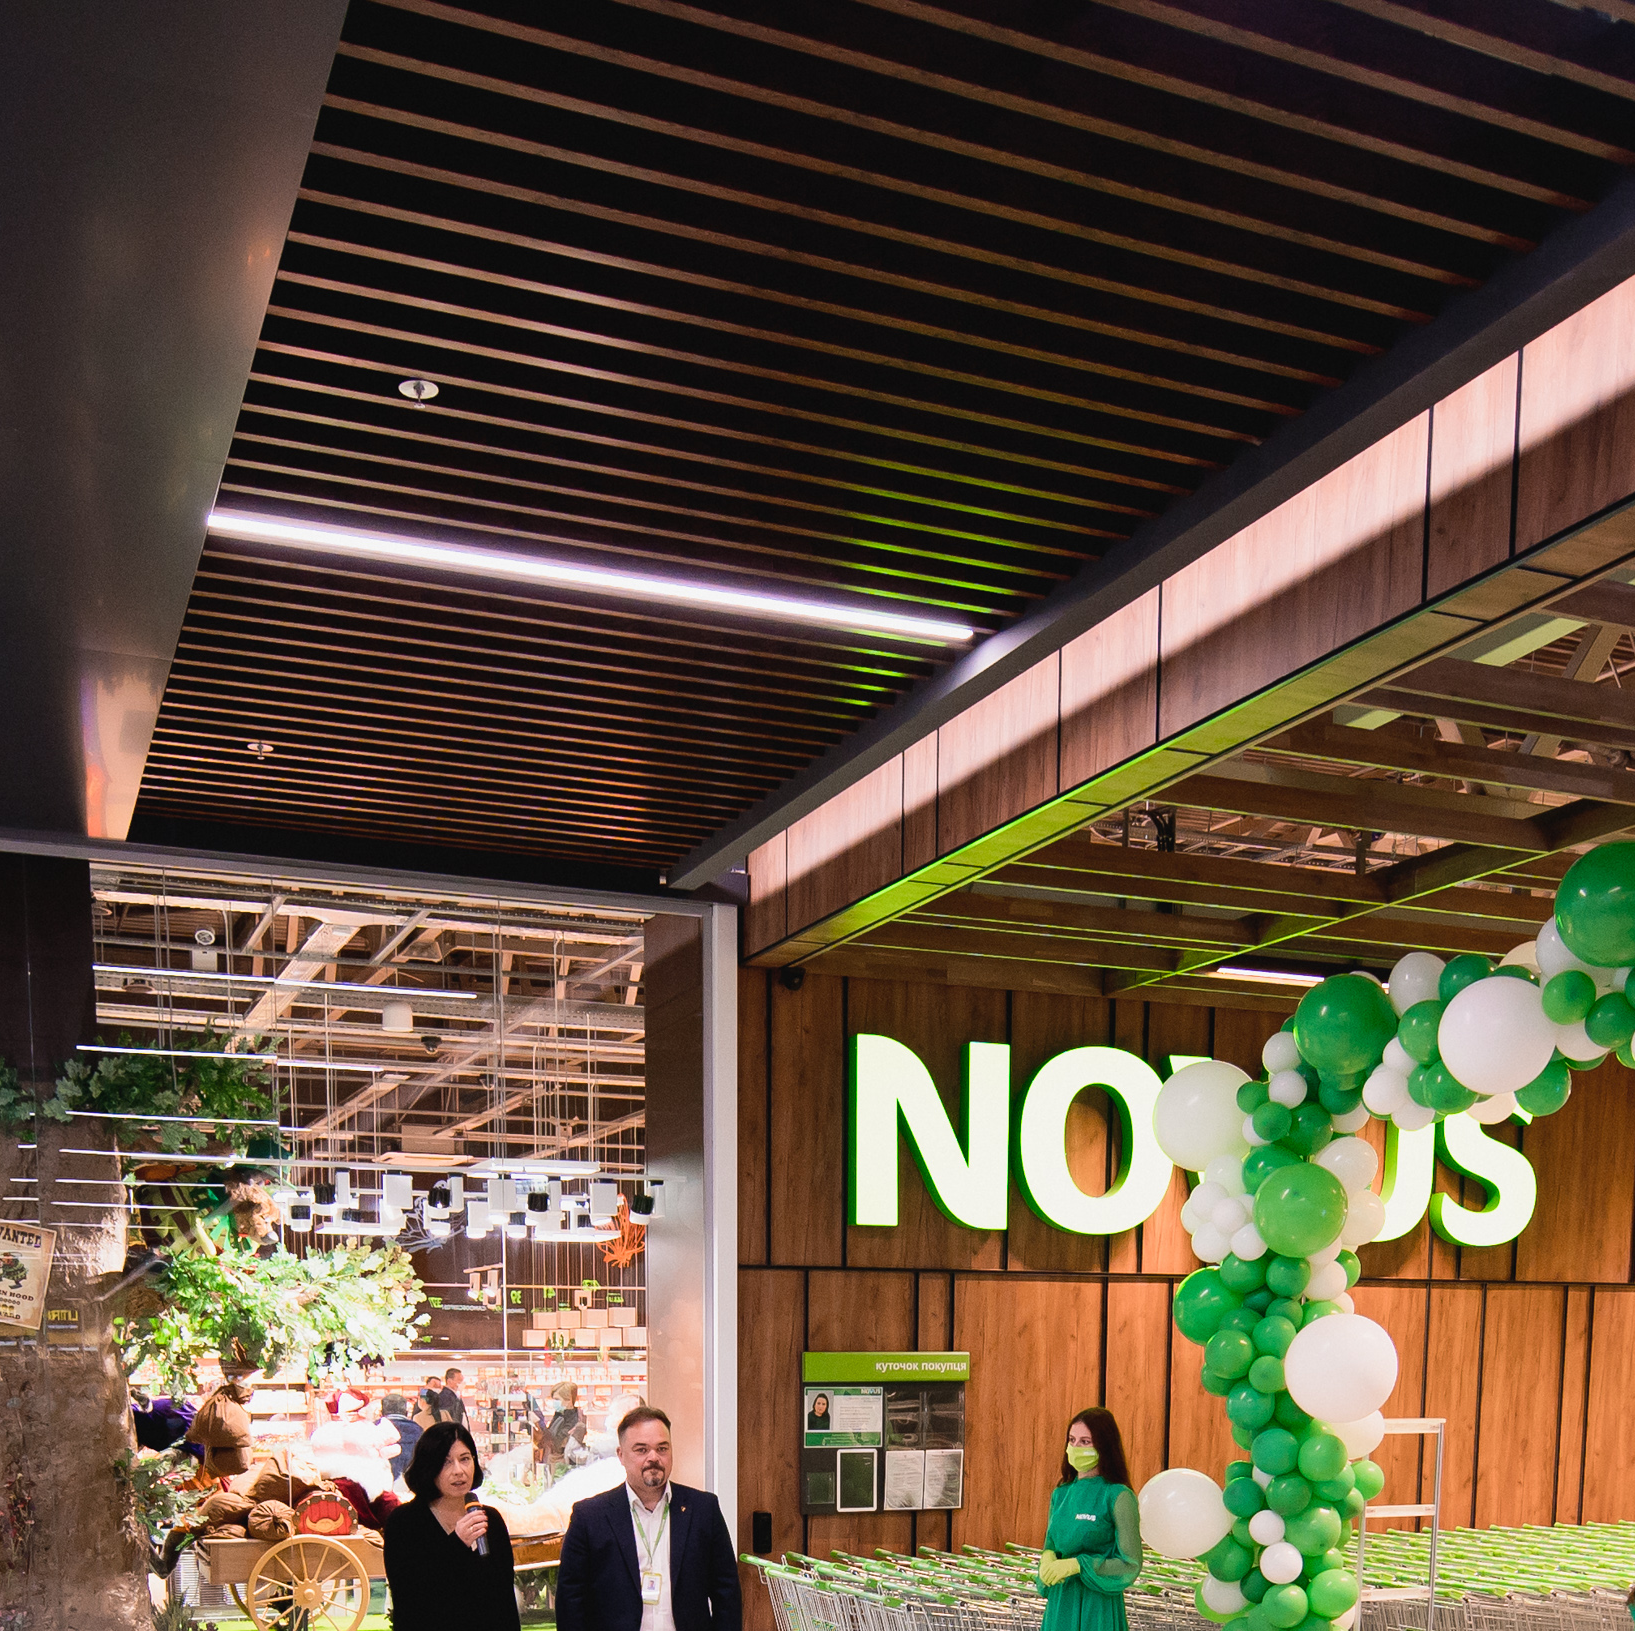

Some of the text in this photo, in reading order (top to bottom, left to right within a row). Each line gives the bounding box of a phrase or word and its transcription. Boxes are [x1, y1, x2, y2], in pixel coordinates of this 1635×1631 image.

[848, 1033, 1537, 1248] NOS
[9, 1290, 35, 1302] HOOD
[875, 1362, 967, 1373] куточок покупця
